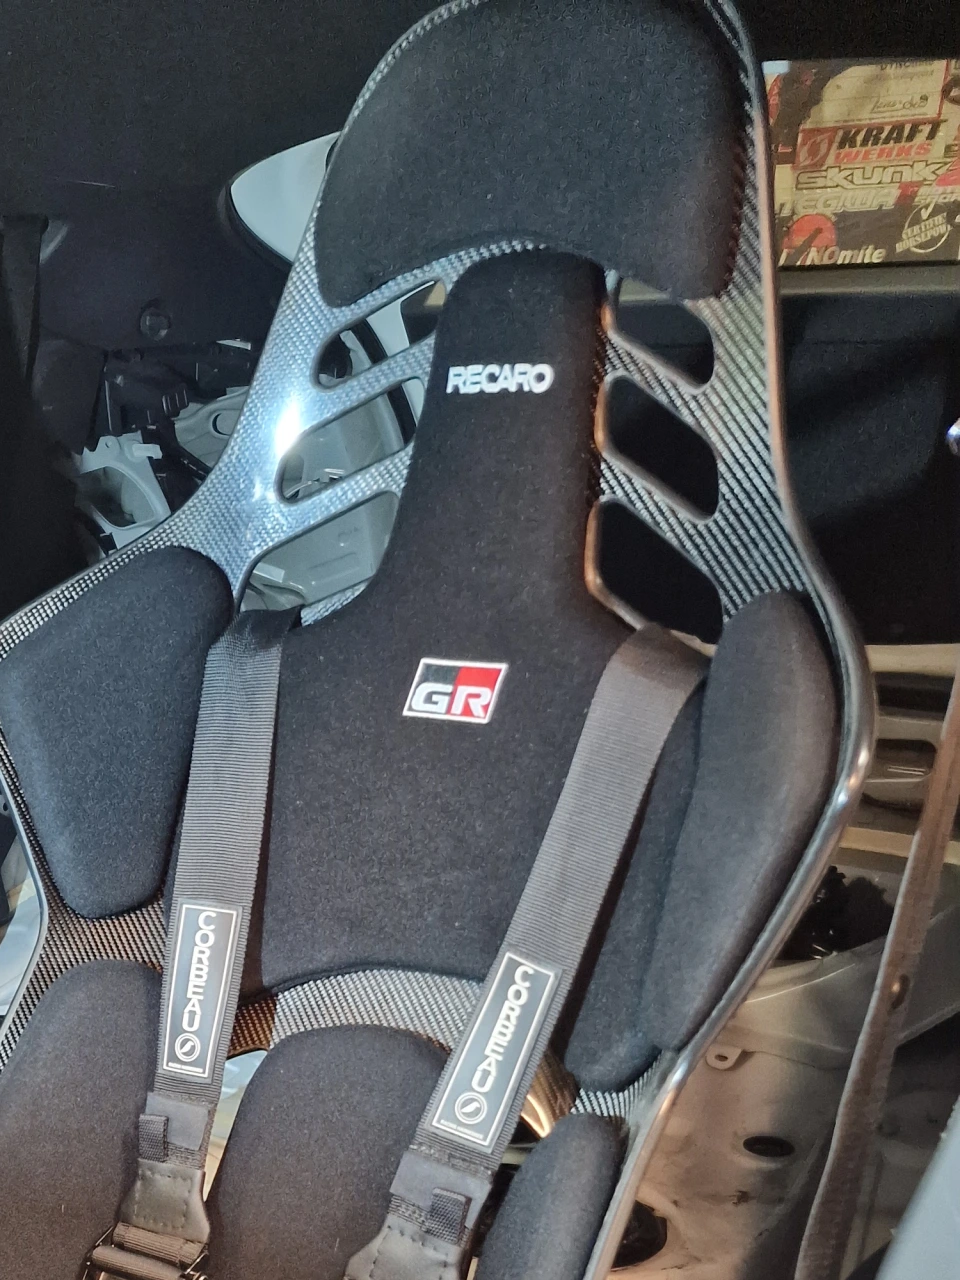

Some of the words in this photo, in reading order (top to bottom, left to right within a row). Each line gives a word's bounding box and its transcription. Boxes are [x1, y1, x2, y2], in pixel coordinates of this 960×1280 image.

[838, 119, 948, 150] KRAFT
[902, 212, 947, 239] CERTIFIE
[446, 363, 554, 394] RECARO
[411, 683, 492, 718] GR
[182, 911, 216, 1032] CORBEAU
[471, 965, 535, 1093] CORBEAU
